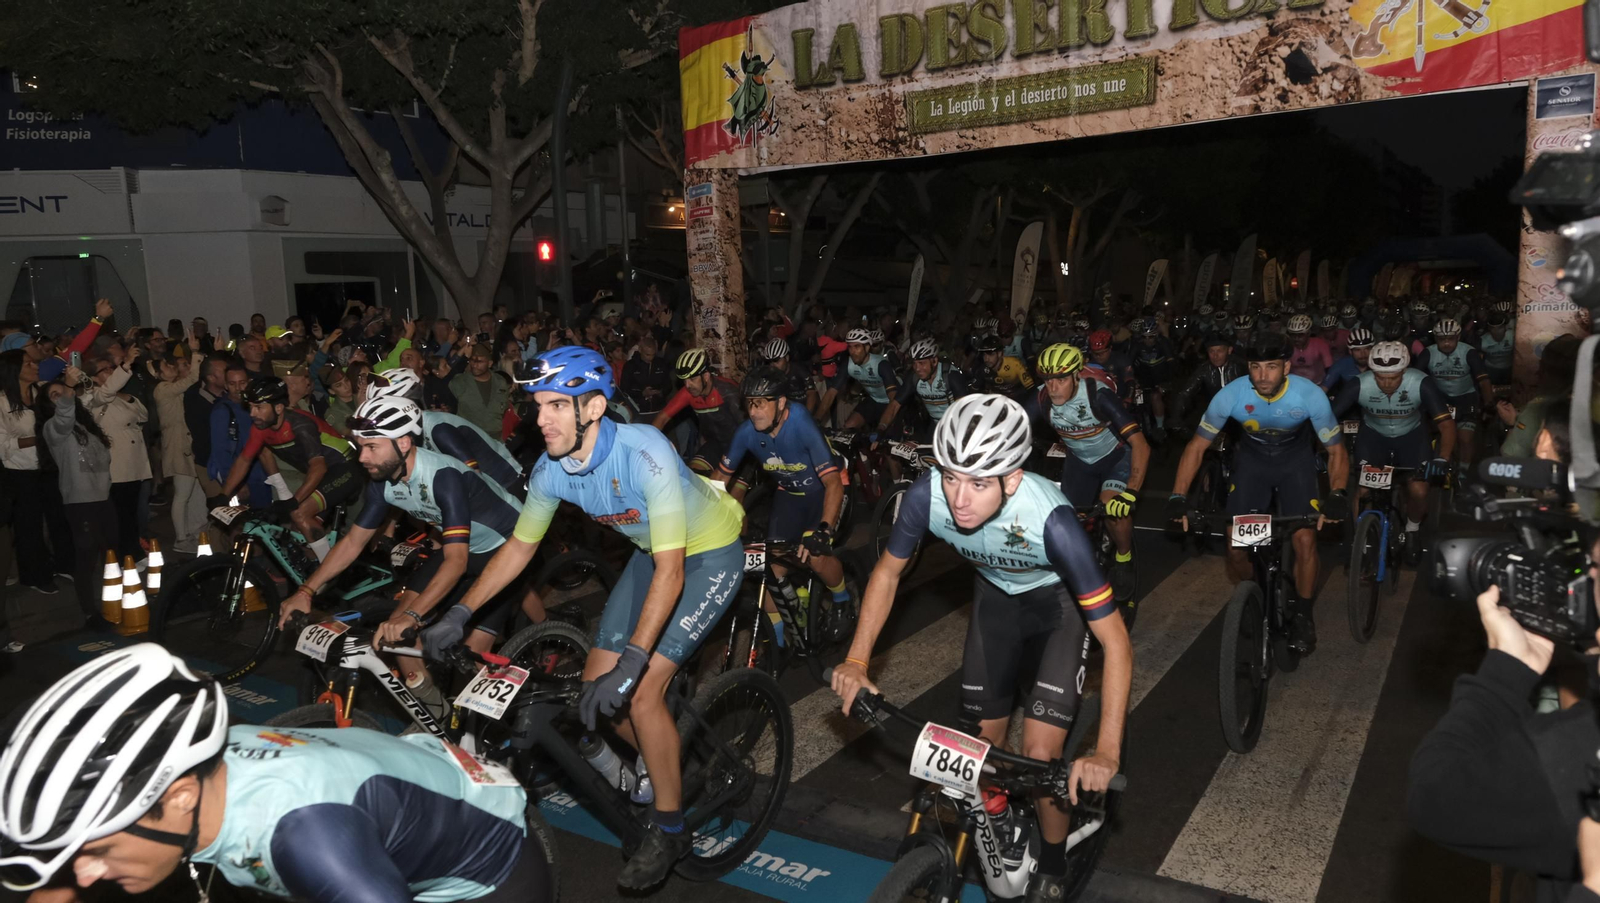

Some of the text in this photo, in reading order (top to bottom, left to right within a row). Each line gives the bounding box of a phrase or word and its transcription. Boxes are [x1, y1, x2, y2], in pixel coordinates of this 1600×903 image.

[792, 23, 863, 90] LA
[930, 78, 1127, 117] La Legión y el desierto nos une
[1547, 96, 1581, 105] SENATOR
[6, 128, 91, 142] Fisioterapia
[1365, 472, 1389, 483] 6677
[1238, 523, 1268, 538] 6464
[689, 571, 739, 641] Bike Race
[304, 625, 336, 649] 9181
[471, 678, 515, 704] 8752
[471, 699, 495, 711] cajamar
[925, 742, 977, 783] 7846
[974, 809, 1003, 879] ORBEA
[766, 873, 809, 892] RURAL
